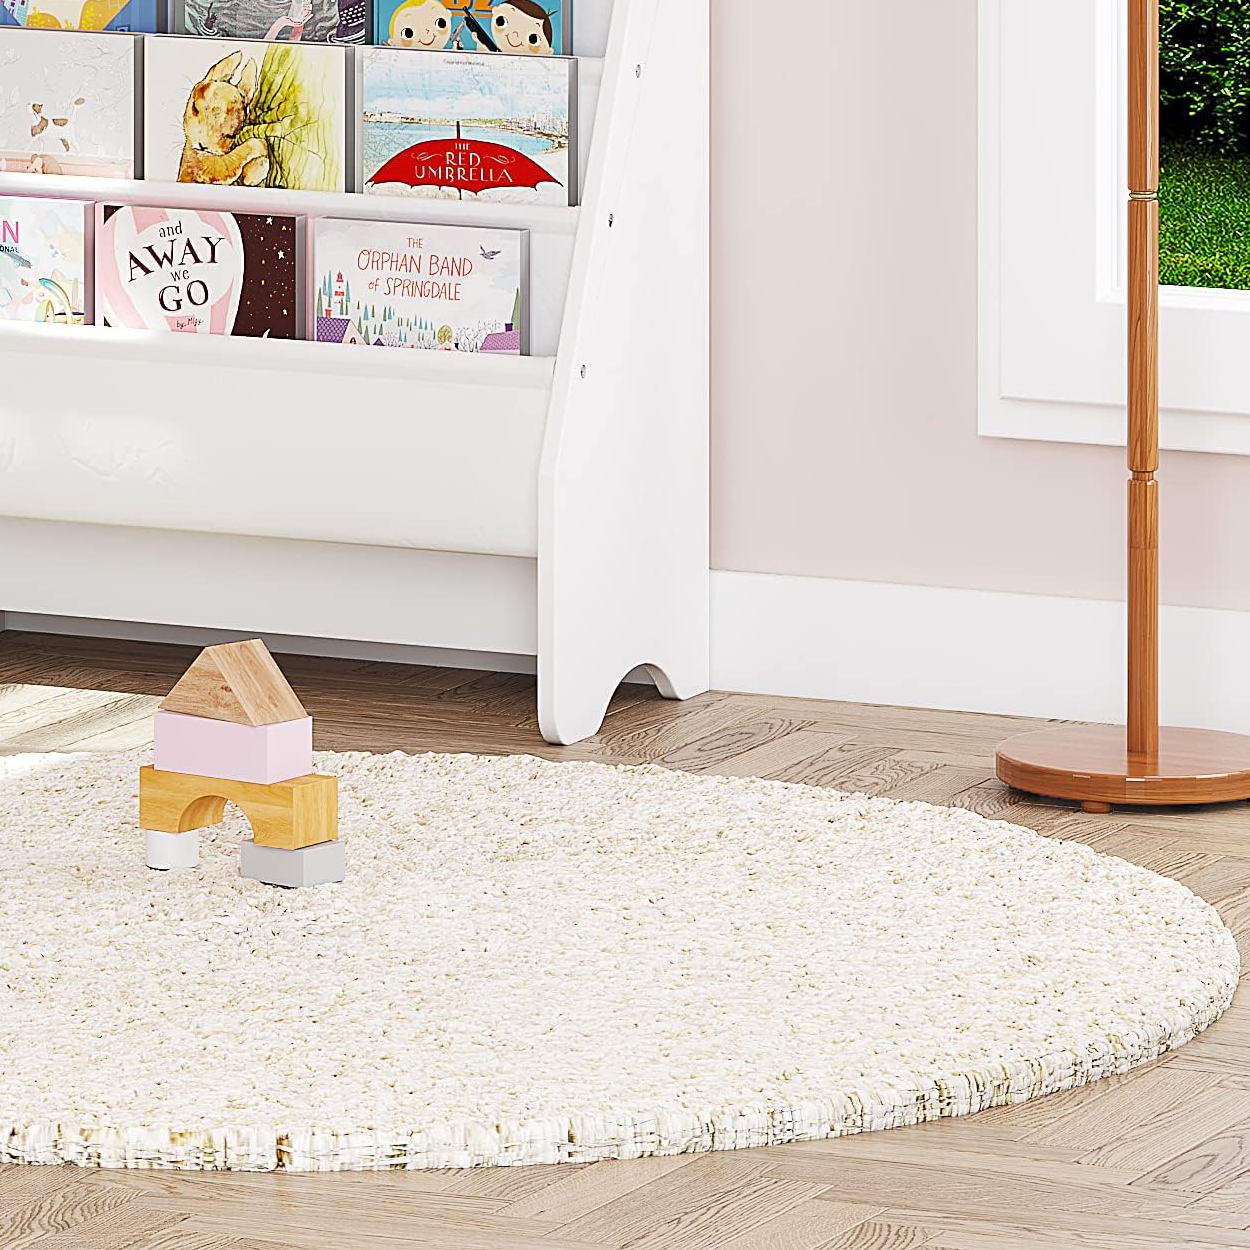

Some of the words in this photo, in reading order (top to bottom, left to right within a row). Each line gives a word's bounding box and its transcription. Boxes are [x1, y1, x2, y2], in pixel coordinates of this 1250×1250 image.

[446, 151, 481, 167] RED
[415, 166, 513, 183] UMBRELLA
[158, 220, 183, 238] and
[407, 237, 423, 249] THE
[128, 236, 225, 282] AWAY
[357, 249, 422, 274] ORPHAN
[429, 254, 473, 277] BAND
[170, 269, 190, 282] we
[158, 280, 209, 312] GO
[369, 277, 380, 292] of
[383, 277, 462, 301] SPRINGDALE
